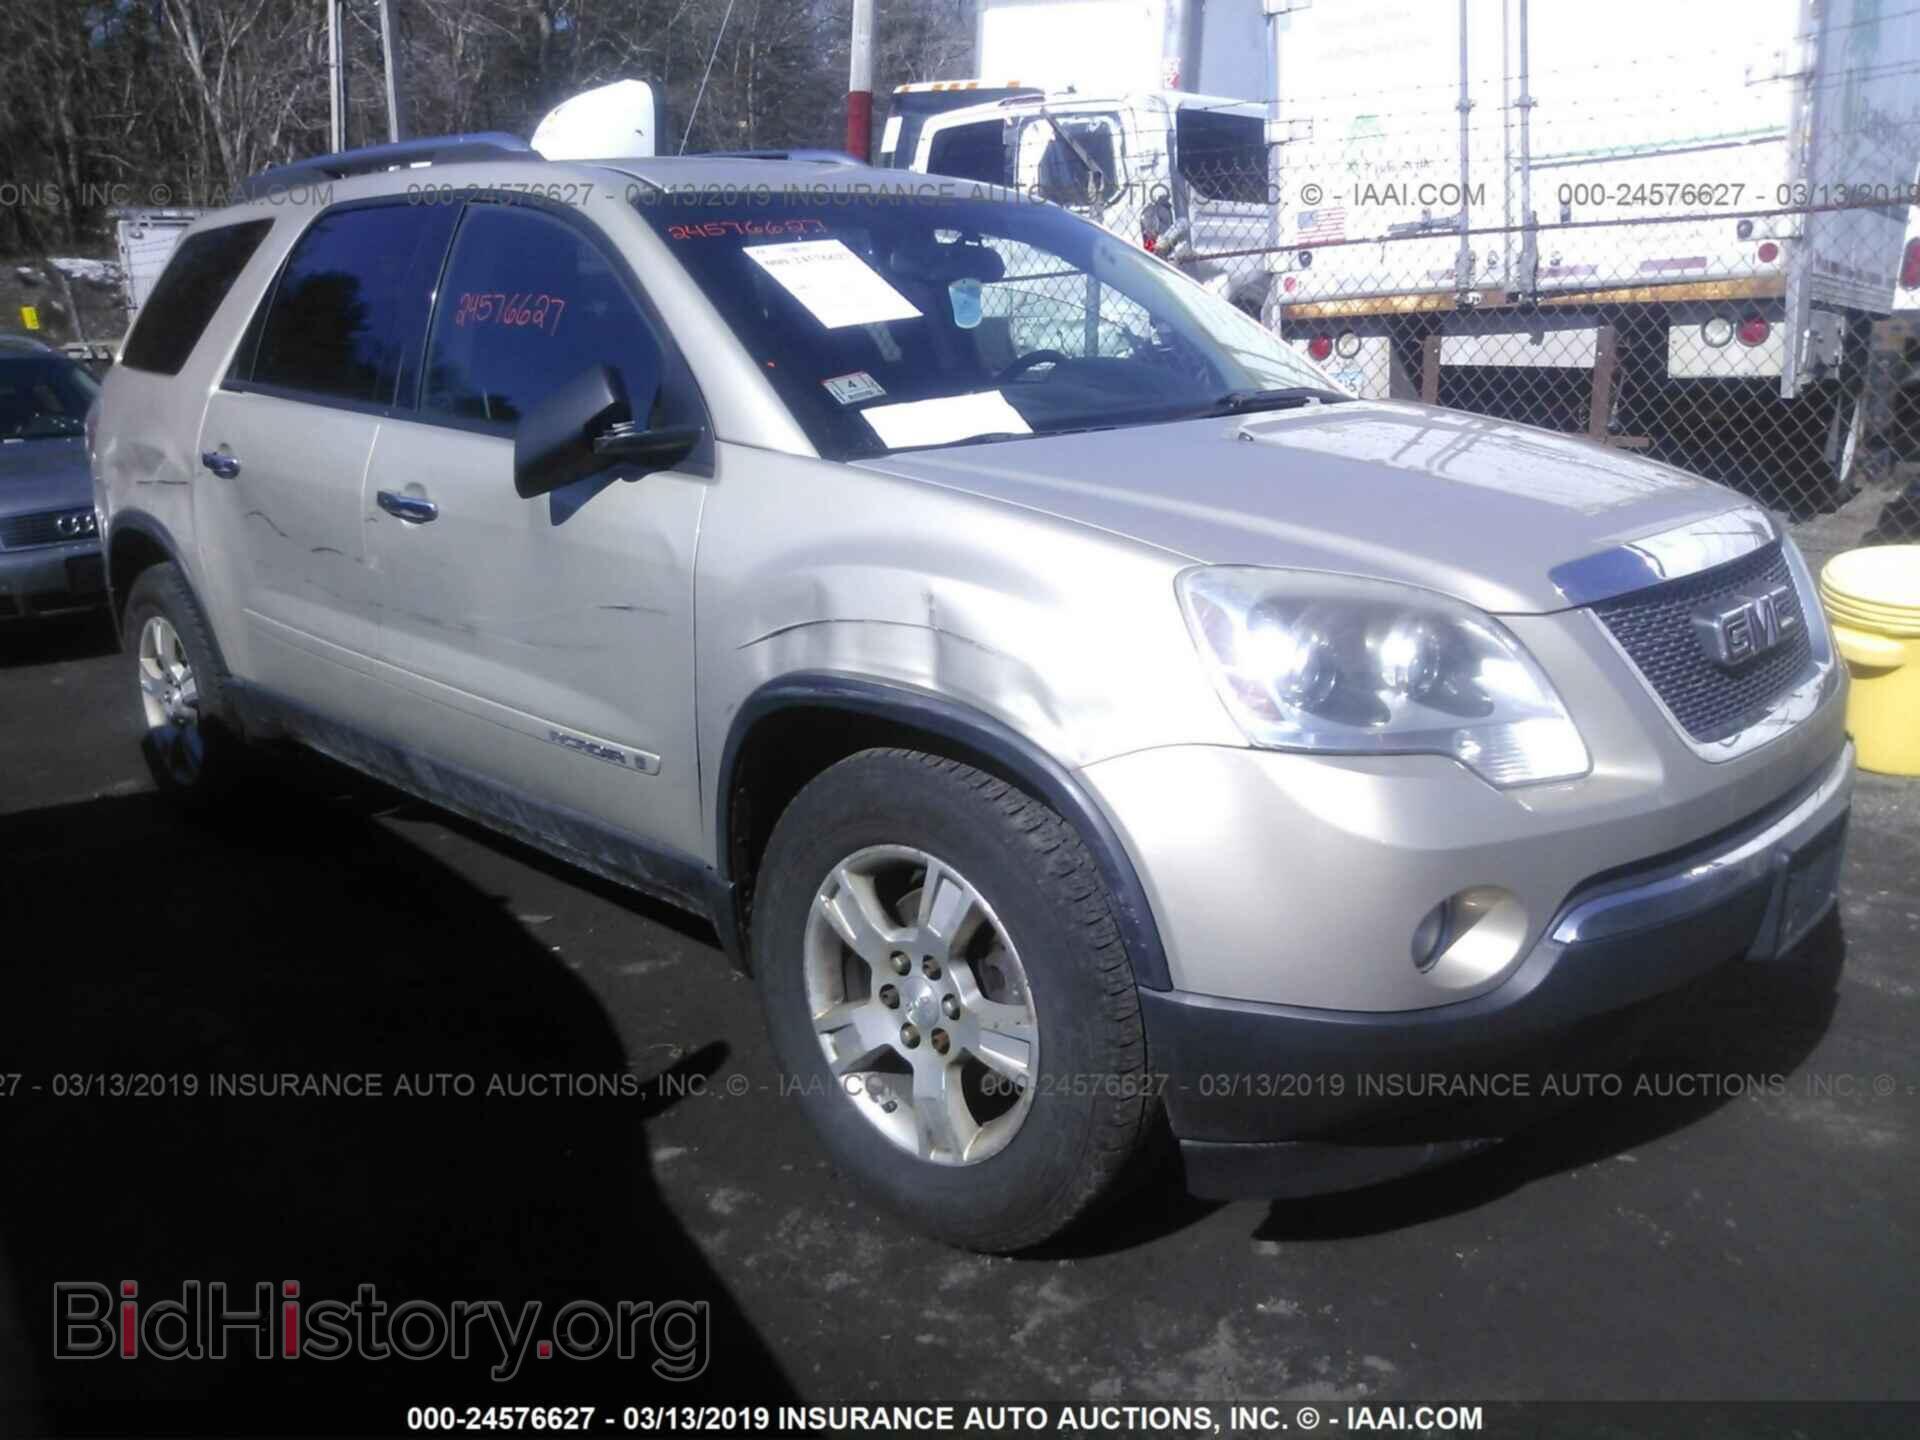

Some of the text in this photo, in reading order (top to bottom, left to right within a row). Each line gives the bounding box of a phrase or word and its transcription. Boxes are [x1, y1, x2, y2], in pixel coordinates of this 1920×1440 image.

[668, 219, 828, 240] 24576627
[455, 293, 566, 336] 24576627
[1718, 586, 1796, 666] GMC
